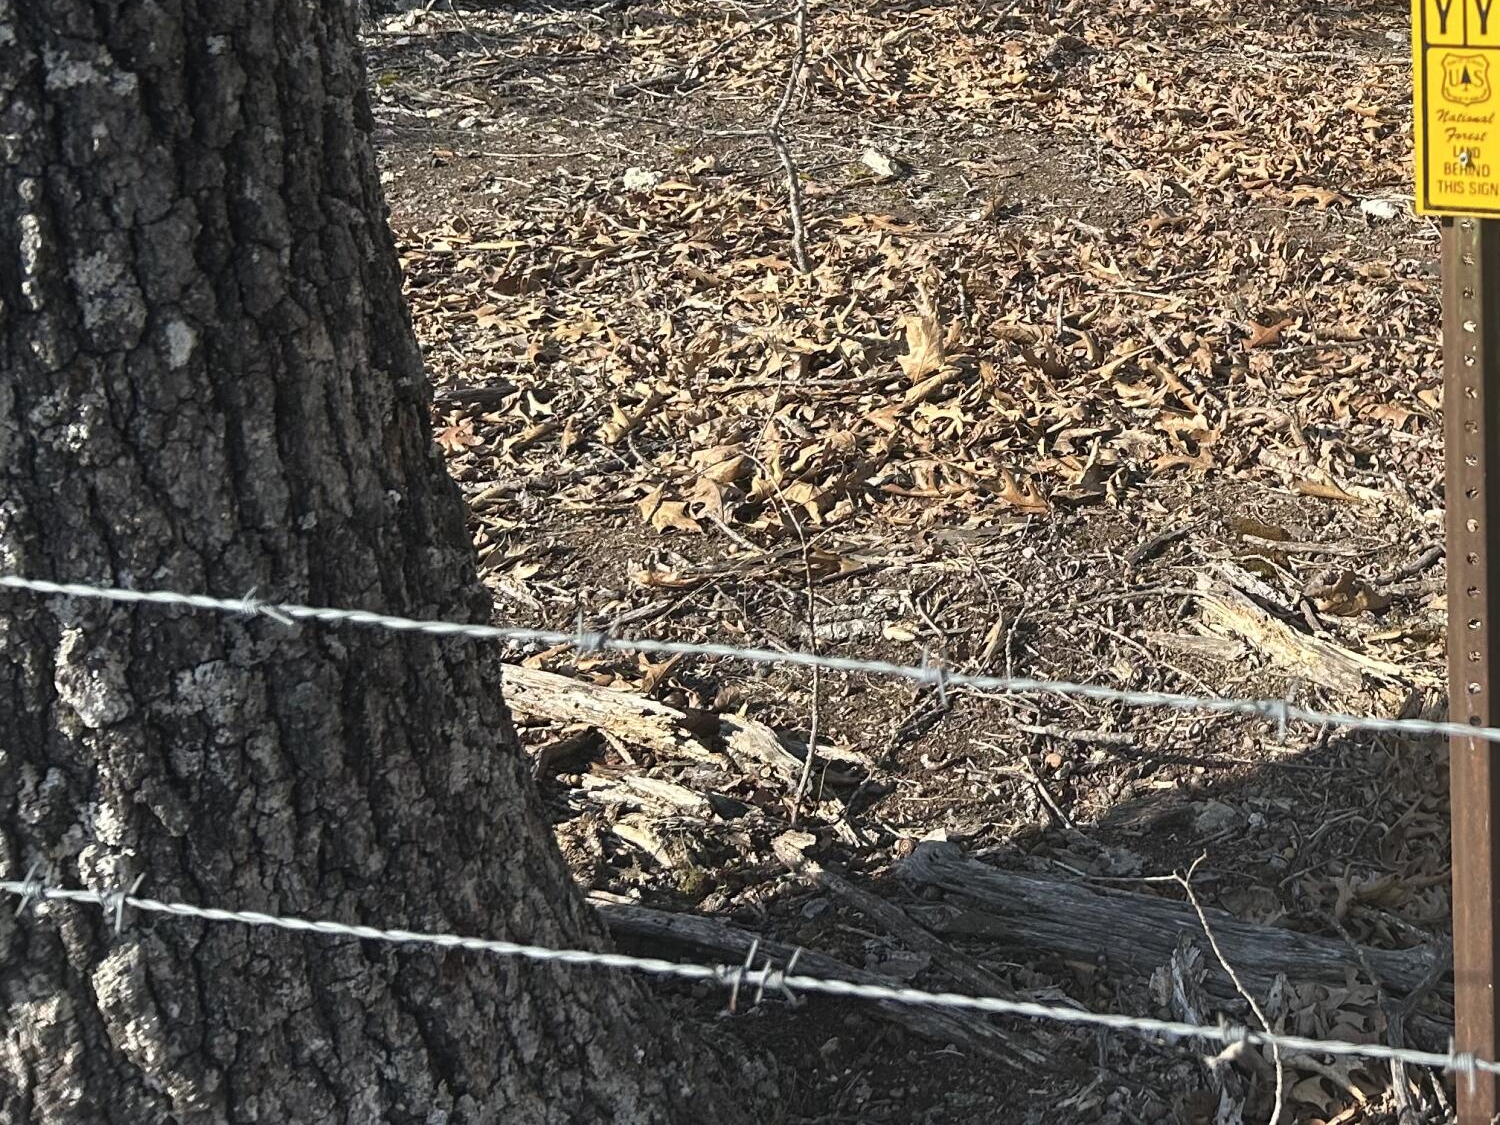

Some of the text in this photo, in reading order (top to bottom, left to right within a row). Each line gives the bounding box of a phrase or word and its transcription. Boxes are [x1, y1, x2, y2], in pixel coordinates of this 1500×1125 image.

[1436, 109, 1495, 124] National
[1445, 127, 1487, 143] Forest
[1437, 179, 1499, 196] THIS SIGN
